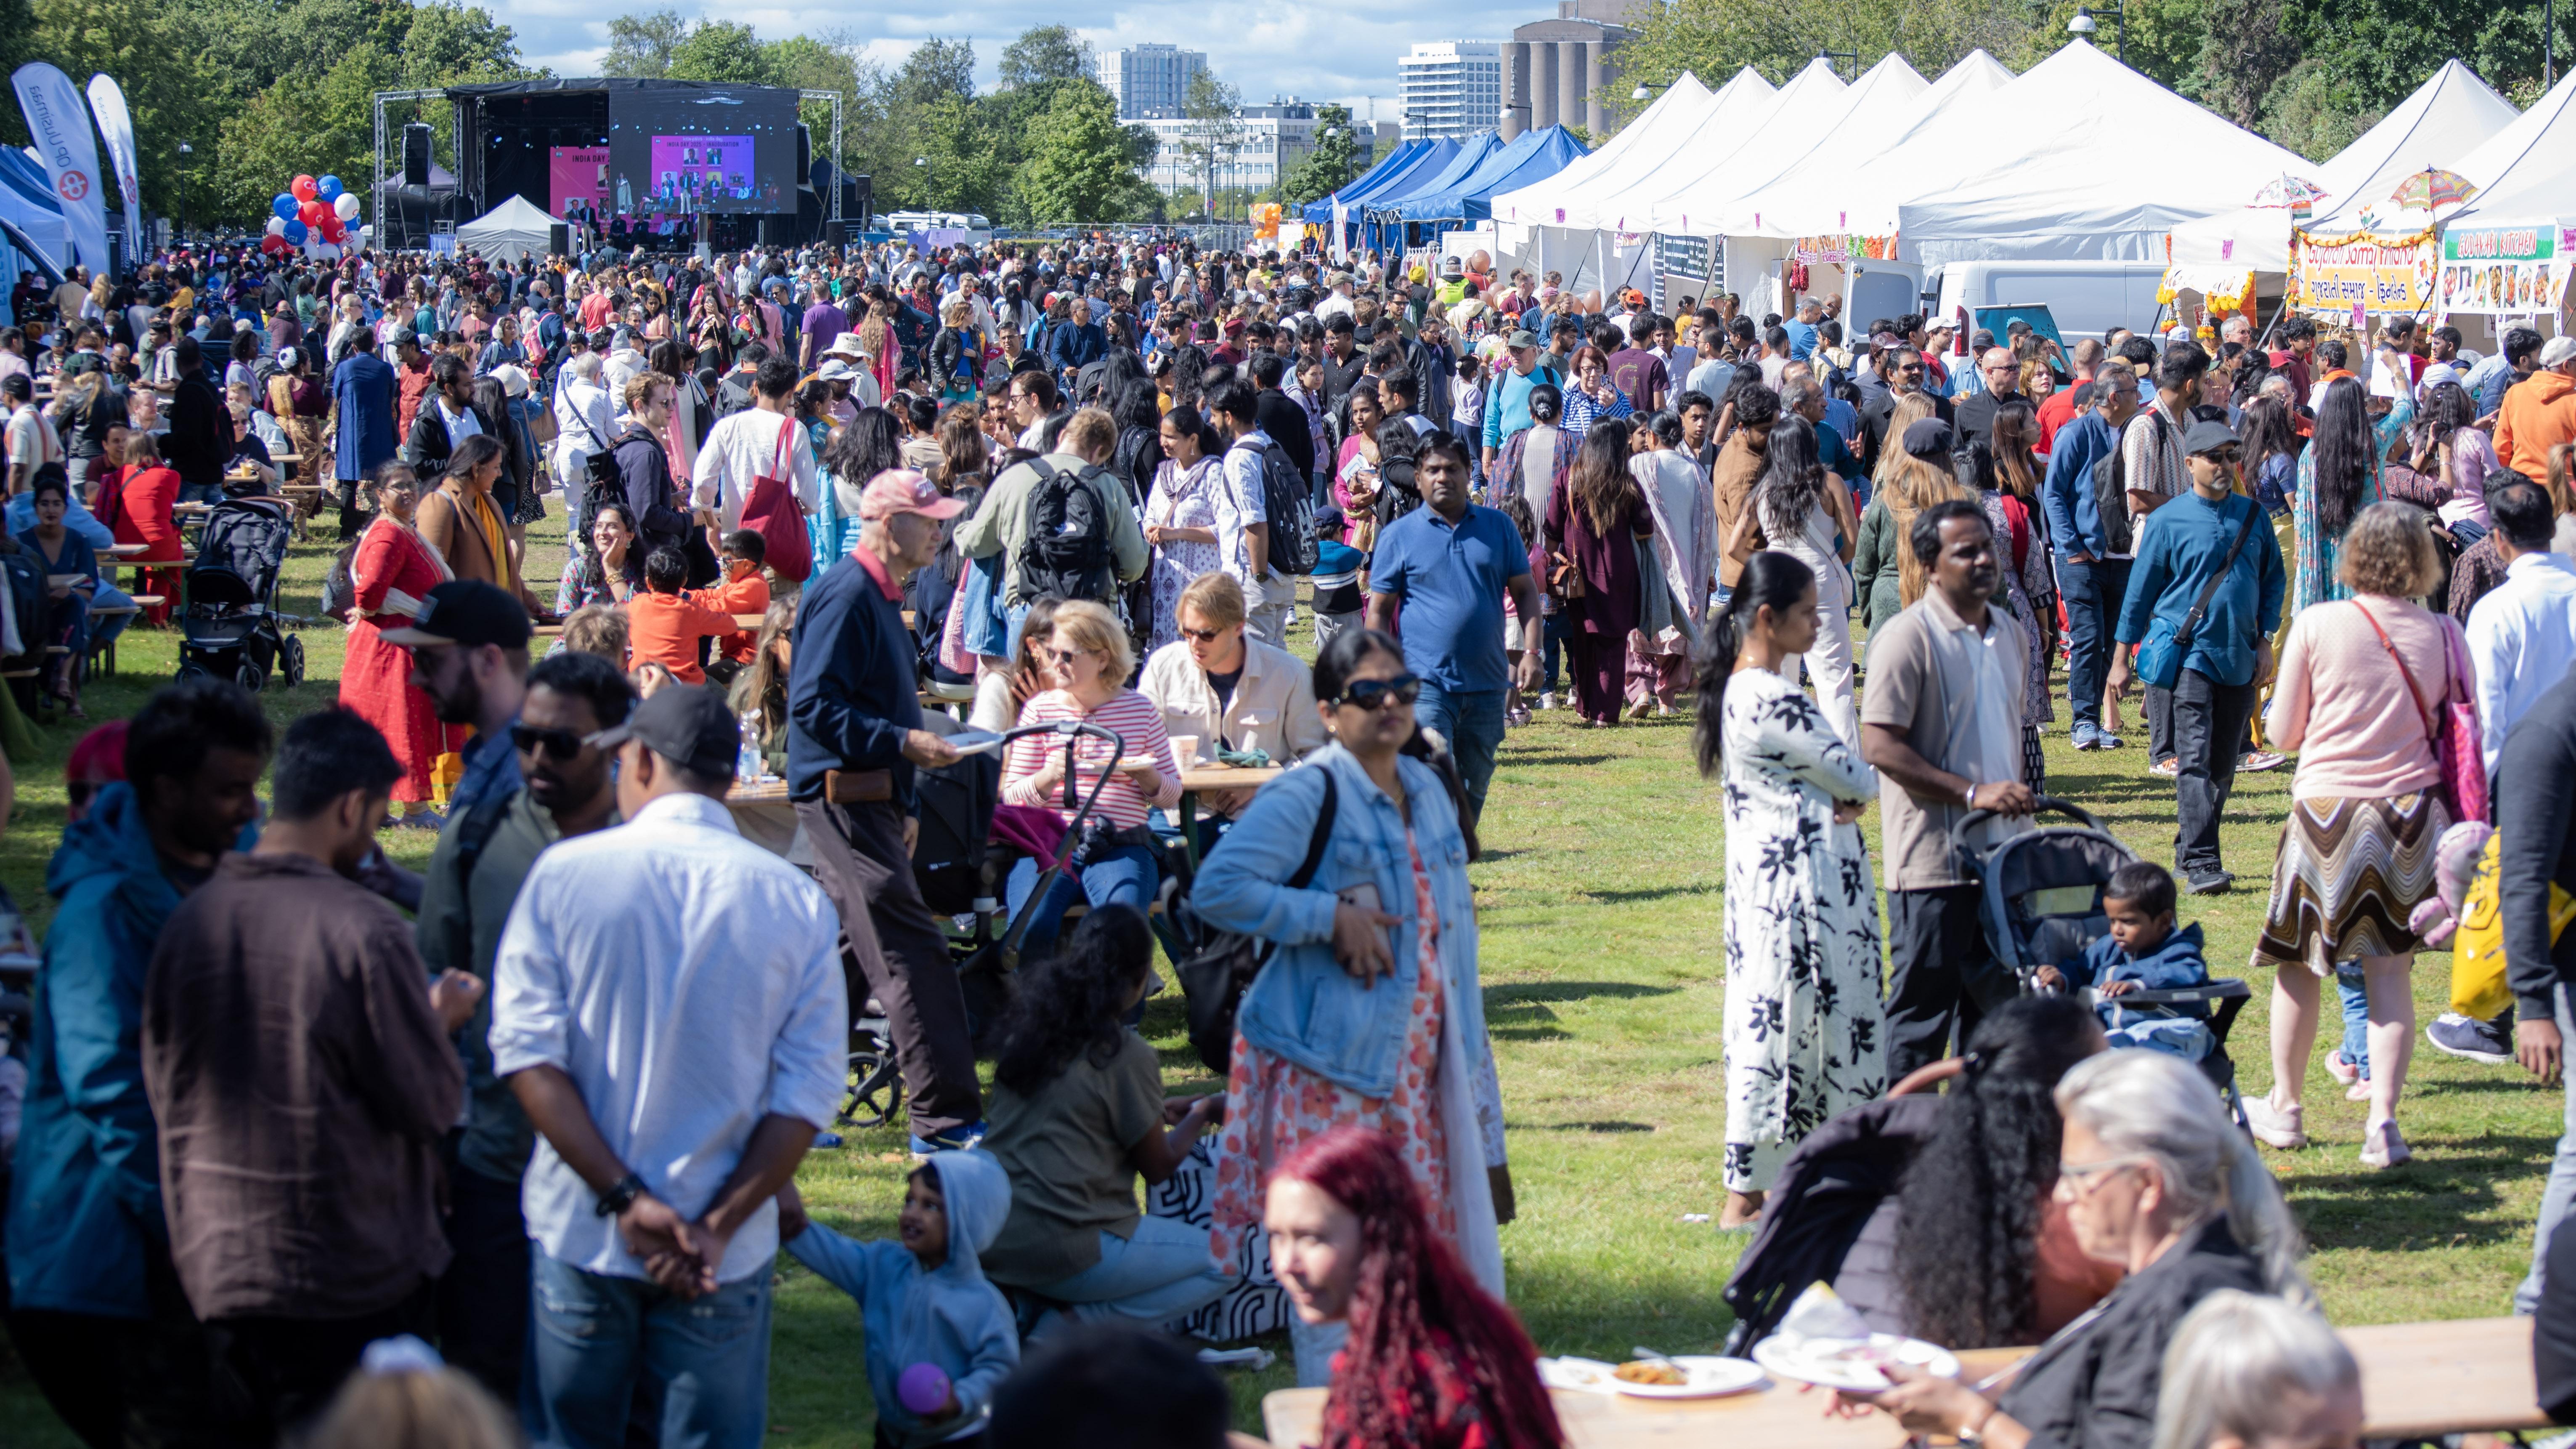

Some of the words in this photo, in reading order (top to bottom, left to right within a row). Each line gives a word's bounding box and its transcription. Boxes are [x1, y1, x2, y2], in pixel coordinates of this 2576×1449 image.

[304, 181, 317, 191] CG
[284, 202, 298, 212] CG
[337, 226, 347, 238] CG
[2223, 242, 2233, 259] F07
[2458, 234, 2497, 255] GODAVARI
[2500, 231, 2536, 254] KITCHEN
[2341, 282, 2365, 300] સમાજ
[2354, 307, 2364, 324] F08
